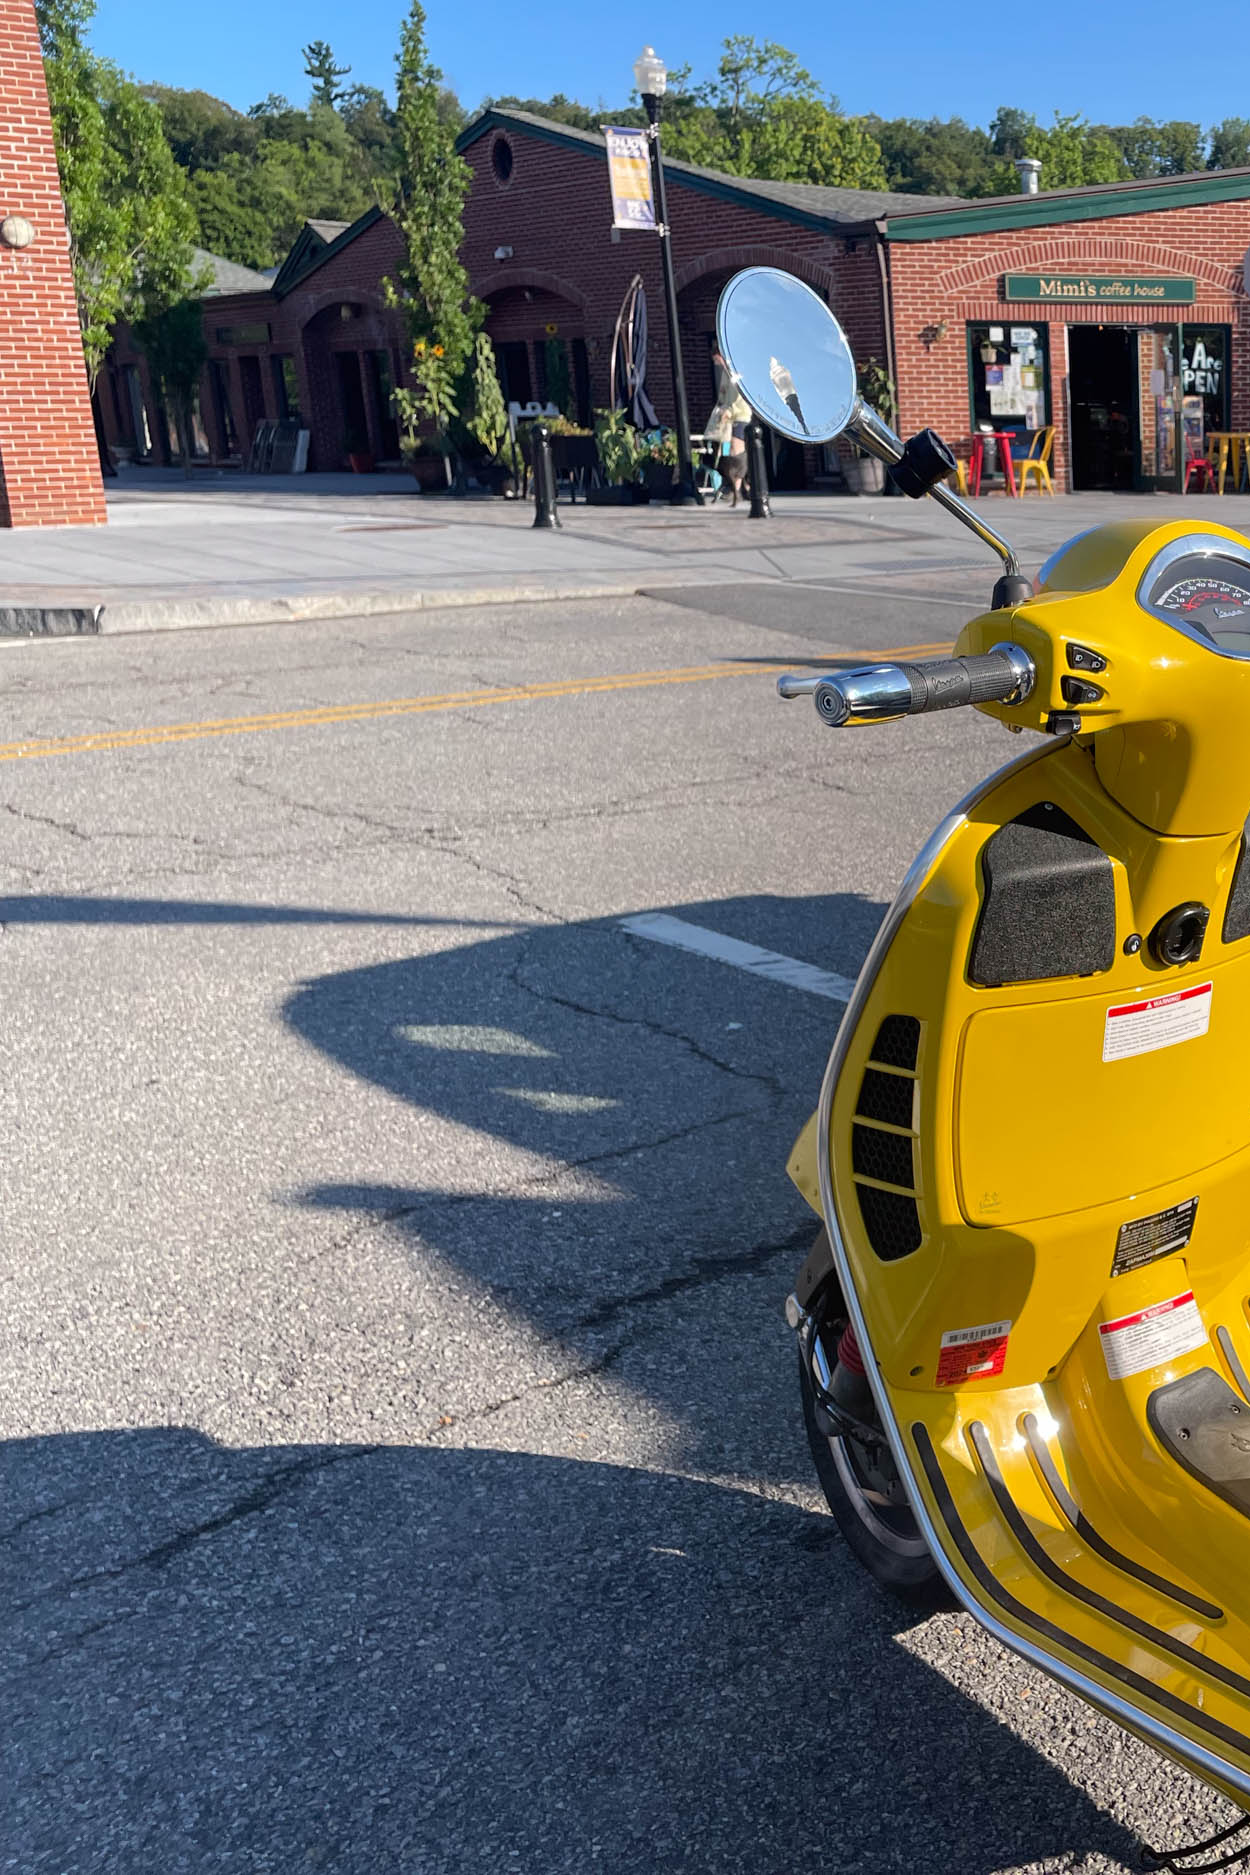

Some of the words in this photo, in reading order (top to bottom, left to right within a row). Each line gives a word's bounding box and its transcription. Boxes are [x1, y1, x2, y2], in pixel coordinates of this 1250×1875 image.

[1039, 279, 1097, 297] Mimi's
[1099, 282, 1131, 297] coffee
[1133, 283, 1165, 297] house
[1191, 342, 1223, 370] Are
[1182, 370, 1220, 395] PEN
